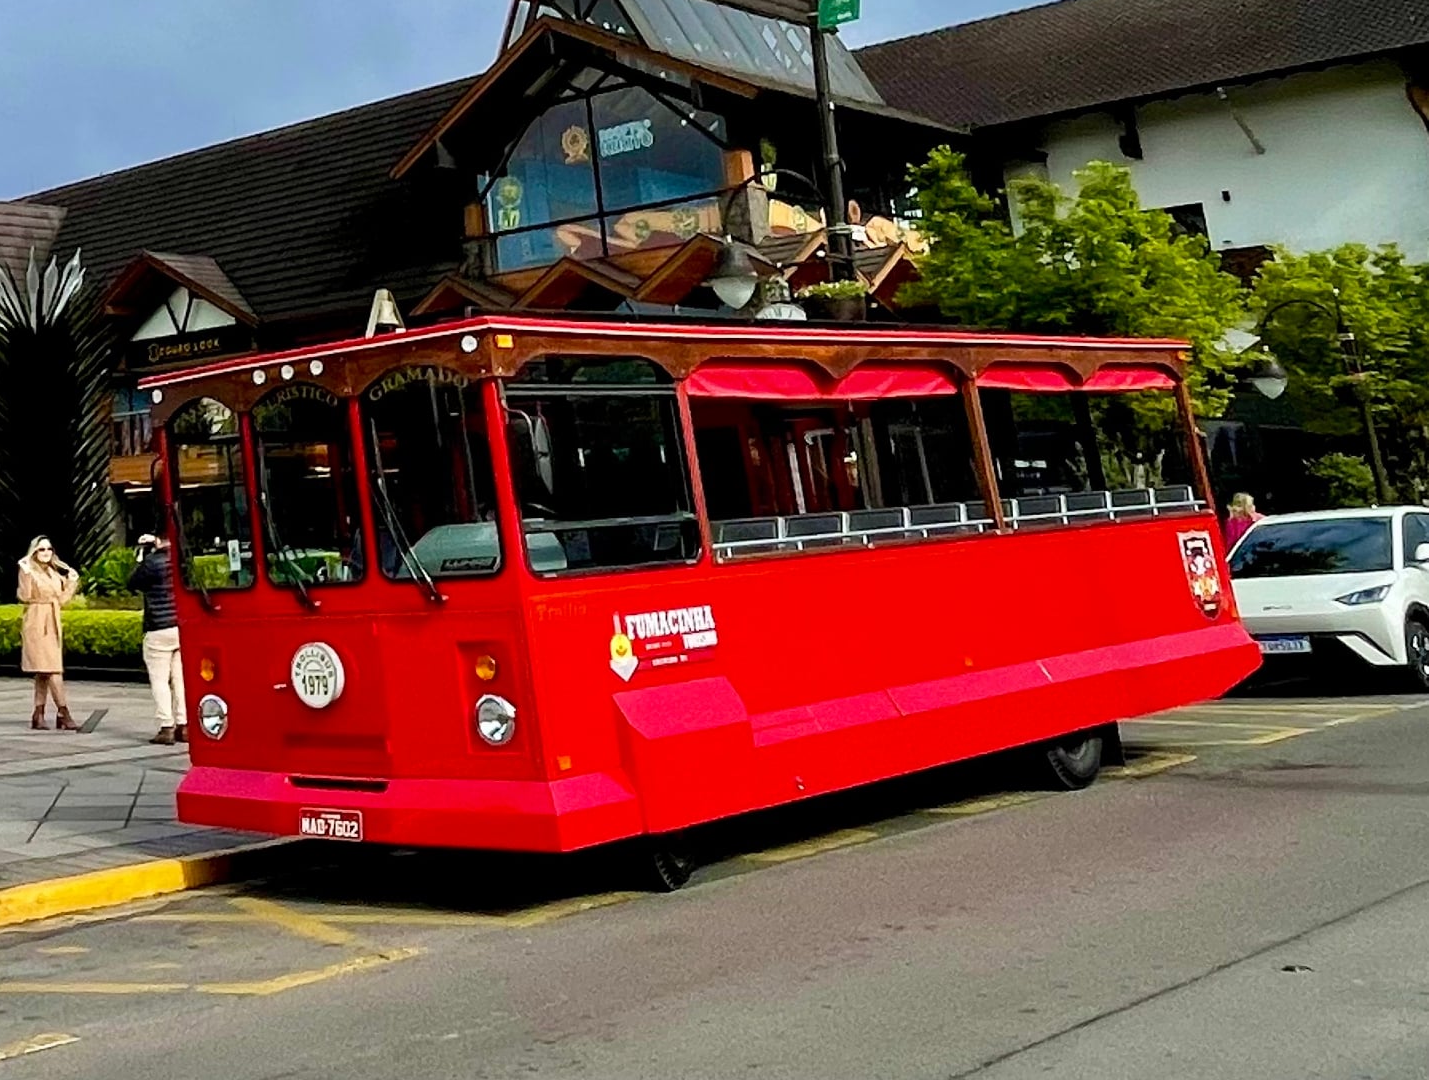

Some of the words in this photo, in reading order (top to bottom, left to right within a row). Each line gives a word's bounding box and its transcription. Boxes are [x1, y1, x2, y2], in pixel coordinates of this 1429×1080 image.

[261, 385, 338, 410] URISTICO
[369, 366, 469, 401] GRAMADO
[624, 604, 716, 640] FUMACINHA
[302, 675, 329, 696] 1979
